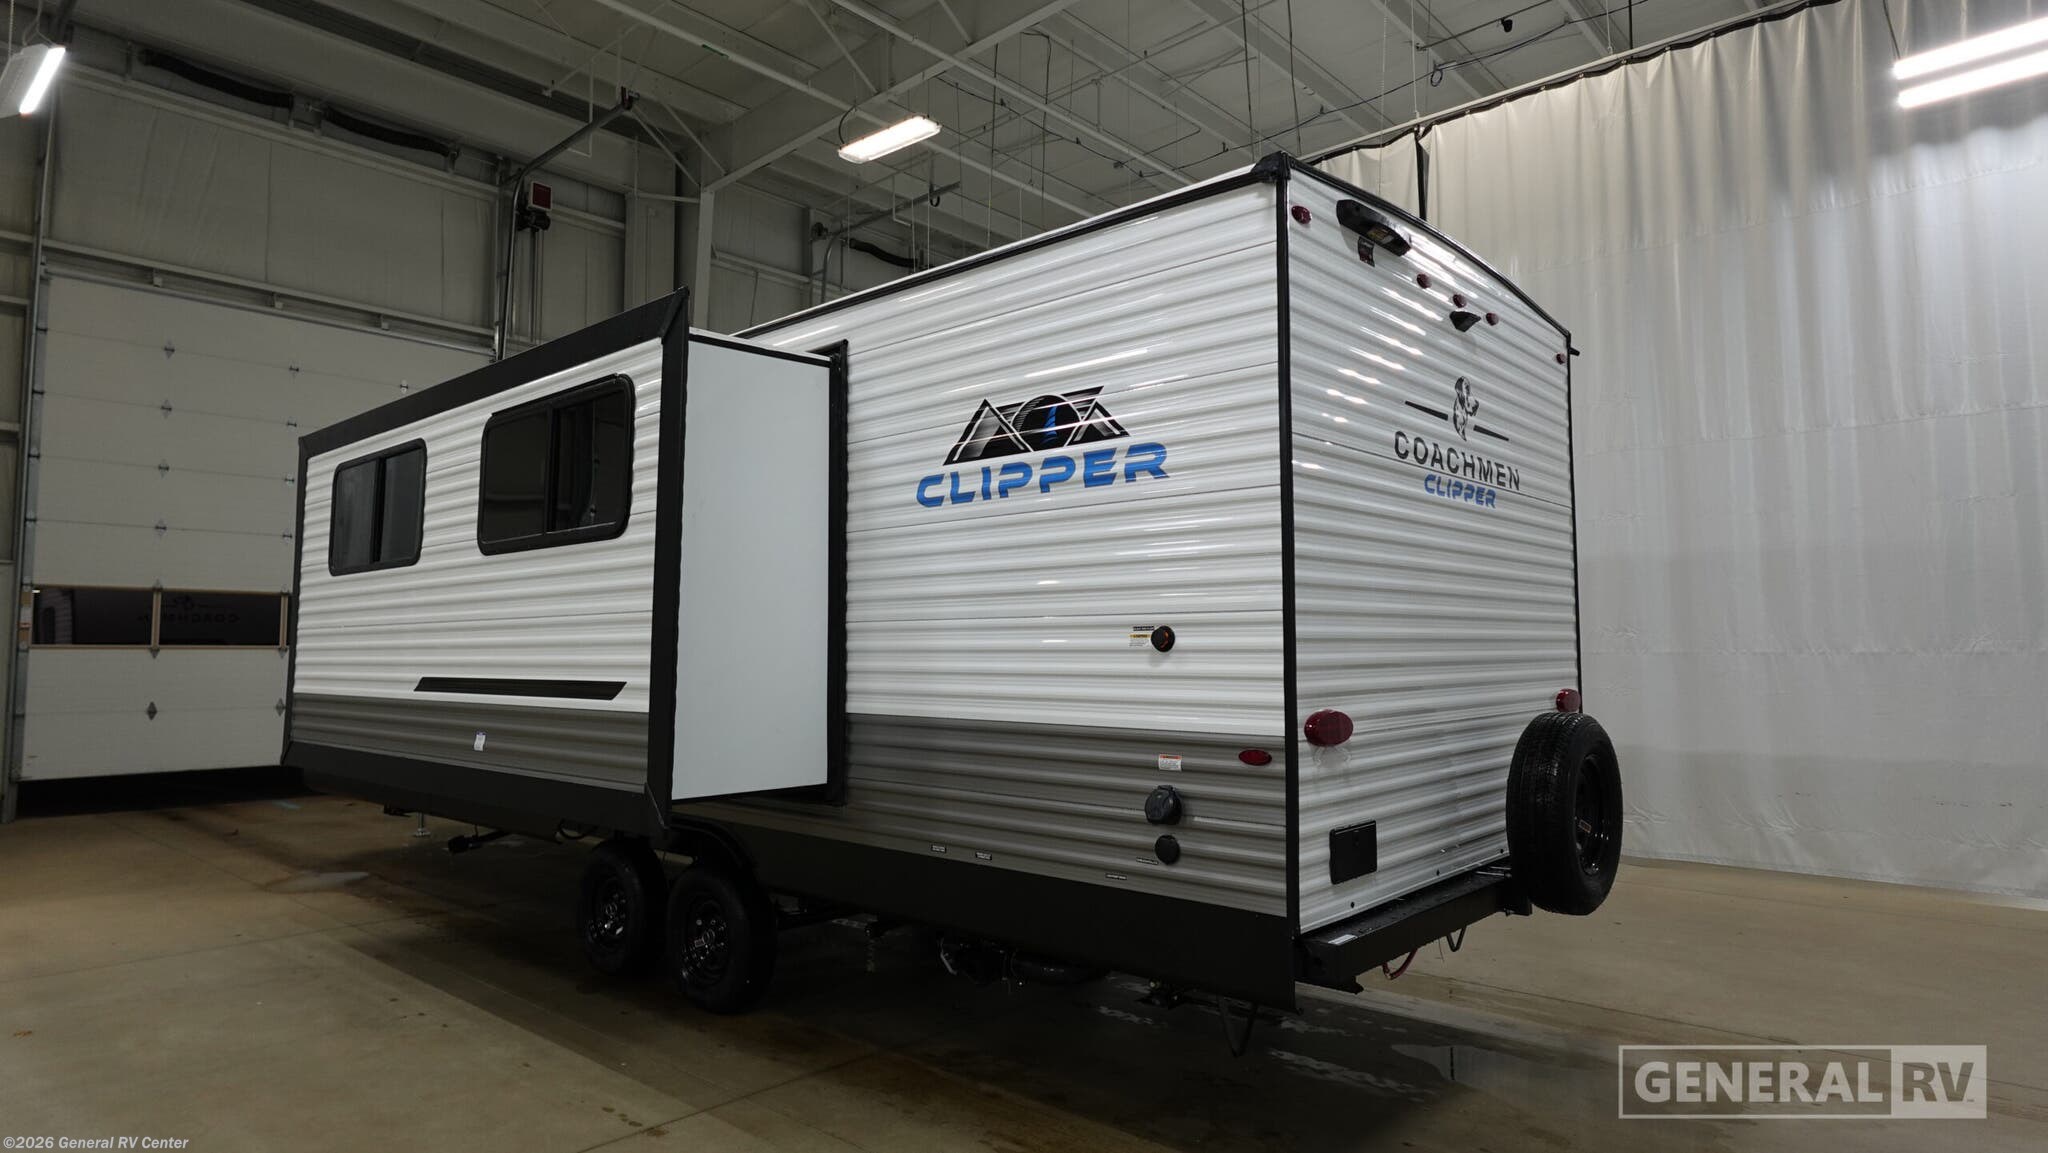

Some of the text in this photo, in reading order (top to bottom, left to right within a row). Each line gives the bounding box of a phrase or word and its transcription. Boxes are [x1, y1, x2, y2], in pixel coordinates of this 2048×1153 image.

[916, 442, 1170, 508] CLIPPER
[1394, 431, 1520, 491] COACHMEN
[1424, 474, 1496, 508] CLIPPER
